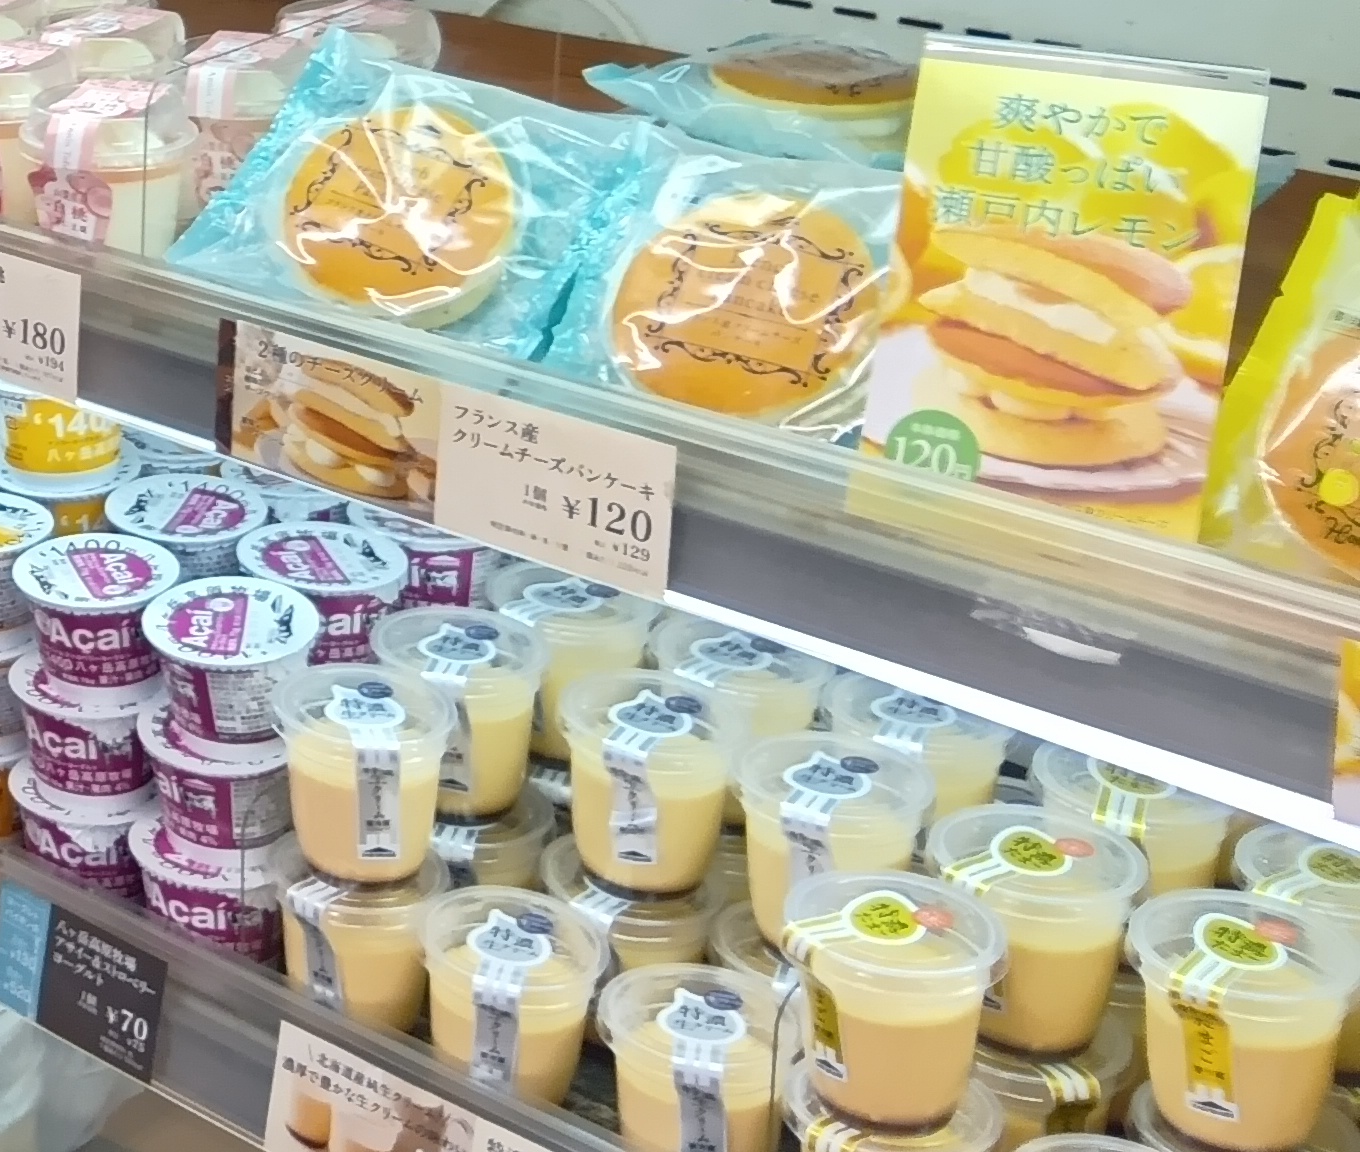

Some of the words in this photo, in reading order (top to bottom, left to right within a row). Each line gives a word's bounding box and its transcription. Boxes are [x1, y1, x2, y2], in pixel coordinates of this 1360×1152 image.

[994, 93, 1169, 148] 爽やかで
[969, 139, 1180, 195] 甘酸っぱい
[934, 184, 1201, 252] 瀬戸内レモン
[1, 316, 66, 356] ¥180
[257, 339, 425, 406] 2種のチーズクリーム
[453, 405, 540, 445] フランス産
[451, 427, 656, 502] クリームチーズパンケーキ
[561, 496, 653, 544] ¥120
[611, 542, 651, 563] ¥129
[48, 617, 132, 654] Açaí
[51, 952, 105, 987] ヨーグルト
[105, 1004, 149, 1042] ¥70
